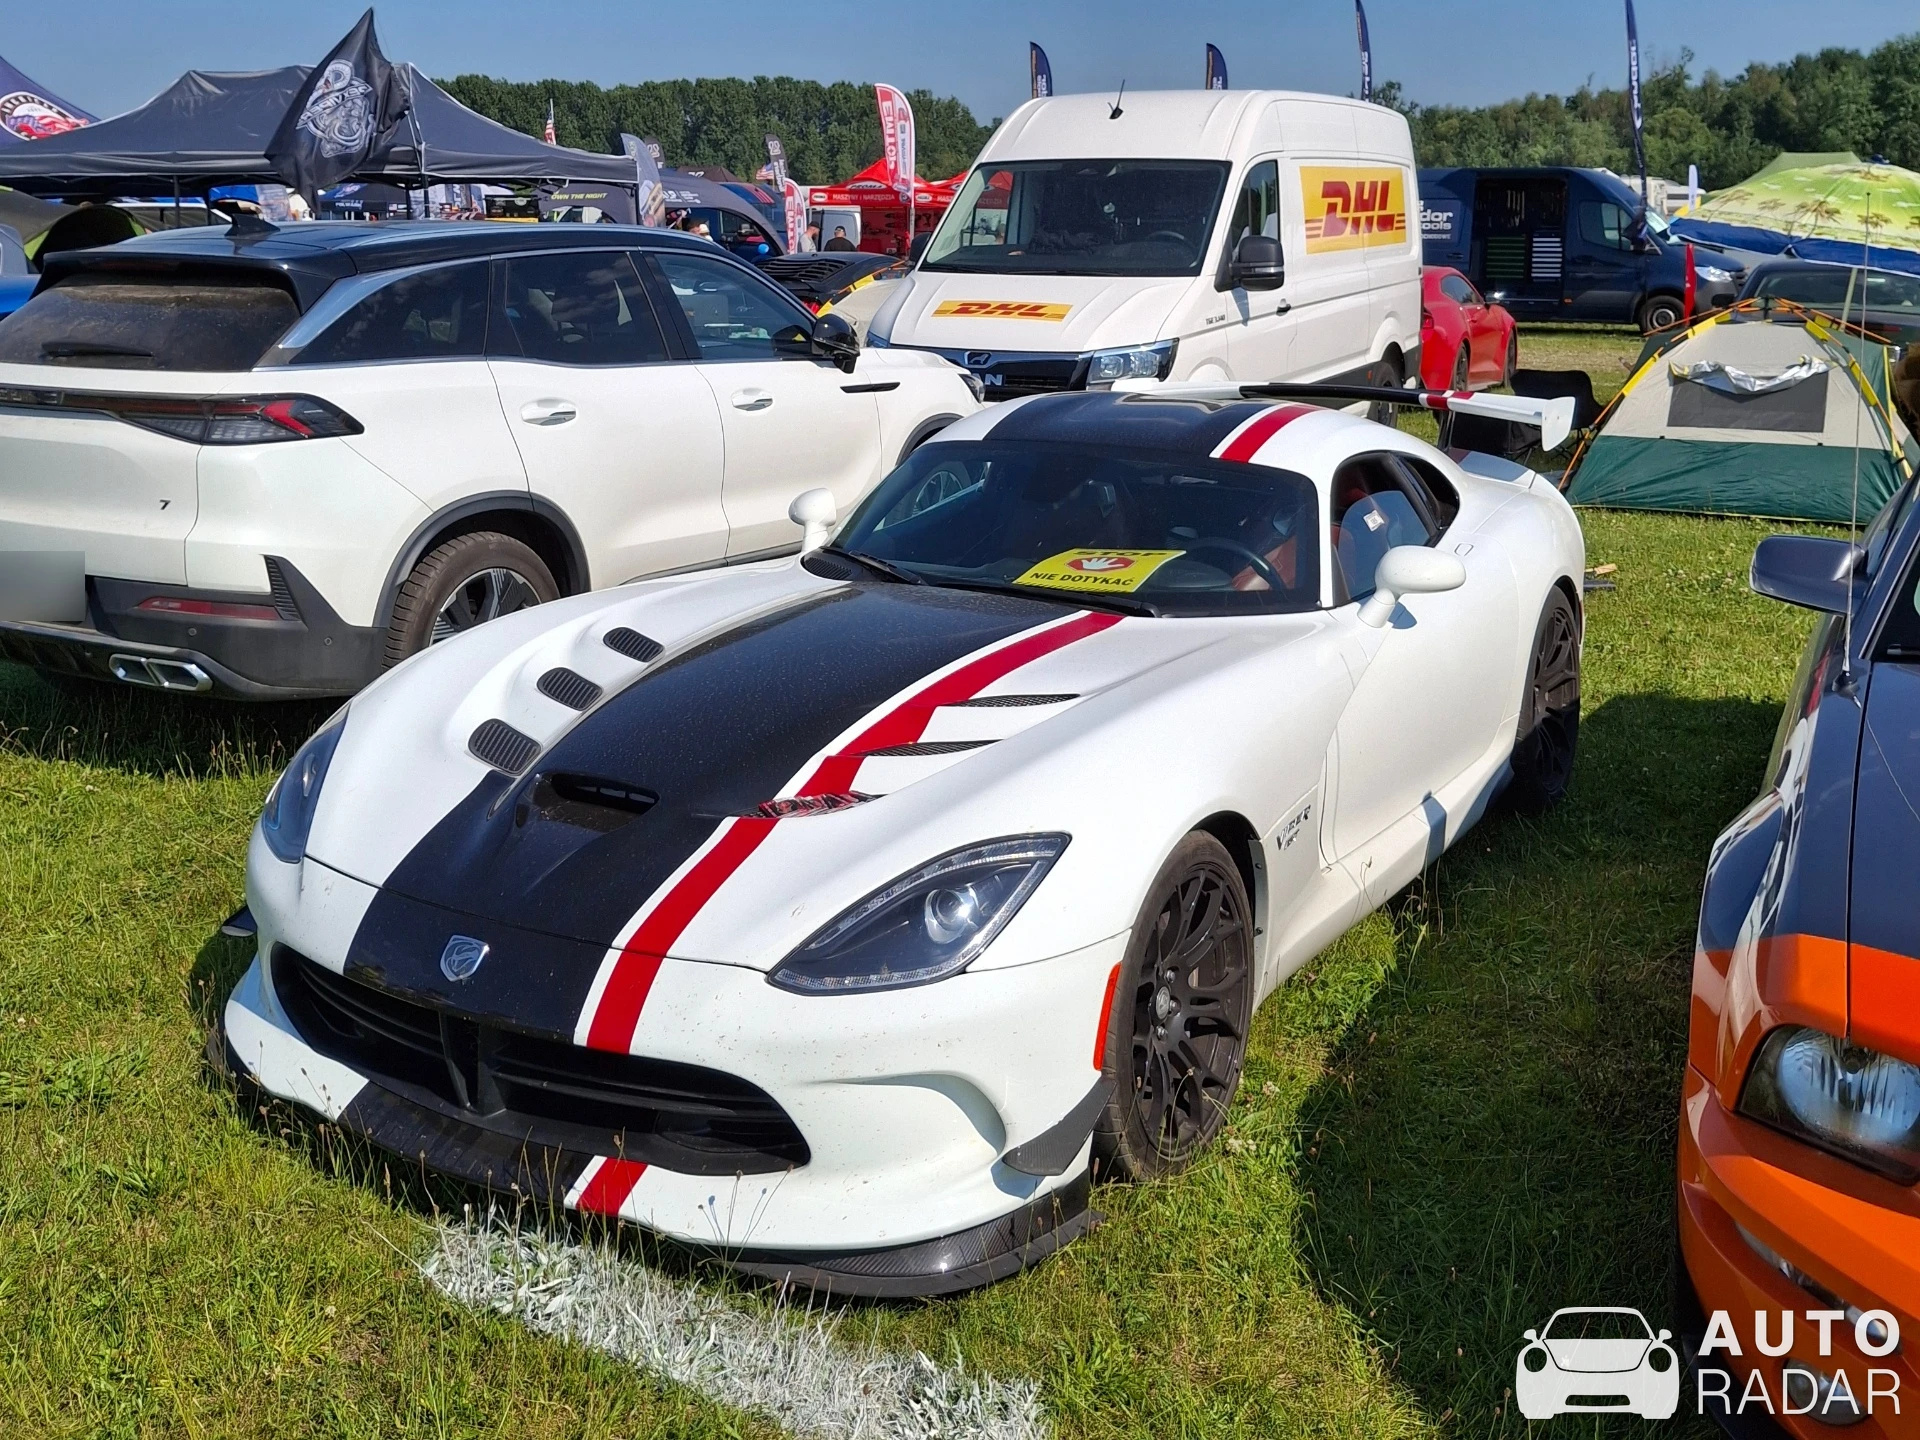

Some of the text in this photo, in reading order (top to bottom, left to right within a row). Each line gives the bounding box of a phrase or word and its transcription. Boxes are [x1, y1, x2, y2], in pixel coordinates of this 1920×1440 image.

[1321, 180, 1395, 238] DHL
[1420, 209, 1453, 221] dor
[1420, 221, 1452, 230] ools
[950, 302, 1048, 317] DHL
[159, 499, 171, 510] 7
[1030, 572, 1134, 586] NIE DOTYKAĆ
